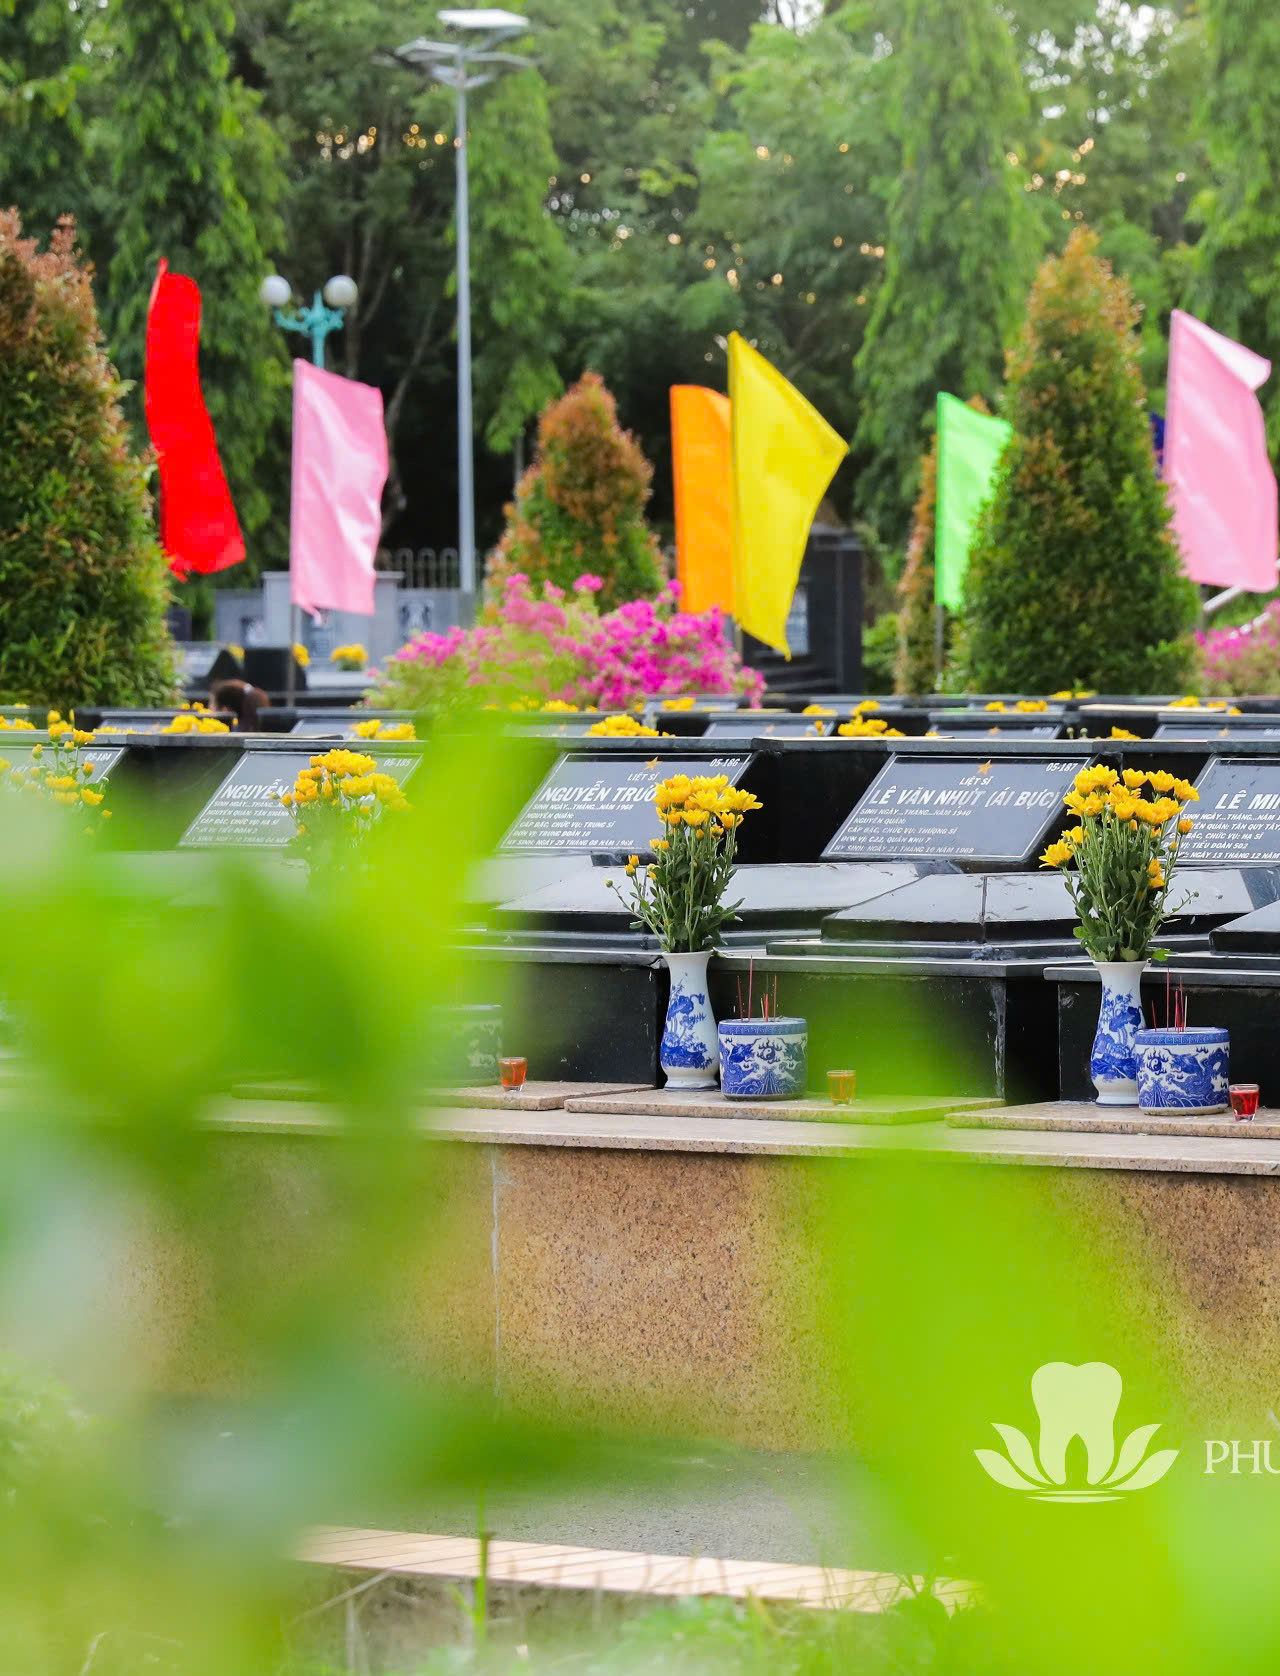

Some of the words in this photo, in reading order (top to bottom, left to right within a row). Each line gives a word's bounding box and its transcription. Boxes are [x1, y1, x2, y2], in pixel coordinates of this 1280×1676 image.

[710, 758, 740, 767] 05-186
[1046, 762, 1078, 772] 05-187
[627, 772, 648, 781] LIỆT
[959, 776, 981, 787] LIỆT
[221, 778, 289, 799] NGUYỄN
[541, 781, 611, 801] NGUYỄN
[869, 786, 897, 805] LÊ
[897, 787, 936, 805] VĂN
[934, 788, 986, 808] NHỰT
[985, 786, 1015, 808] (ÁI
[1013, 789, 1060, 809] BỰC)
[1215, 789, 1248, 810] LÊ
[1192, 840, 1210, 848] TIỂU
[1262, 852, 1280, 860] NĂM
